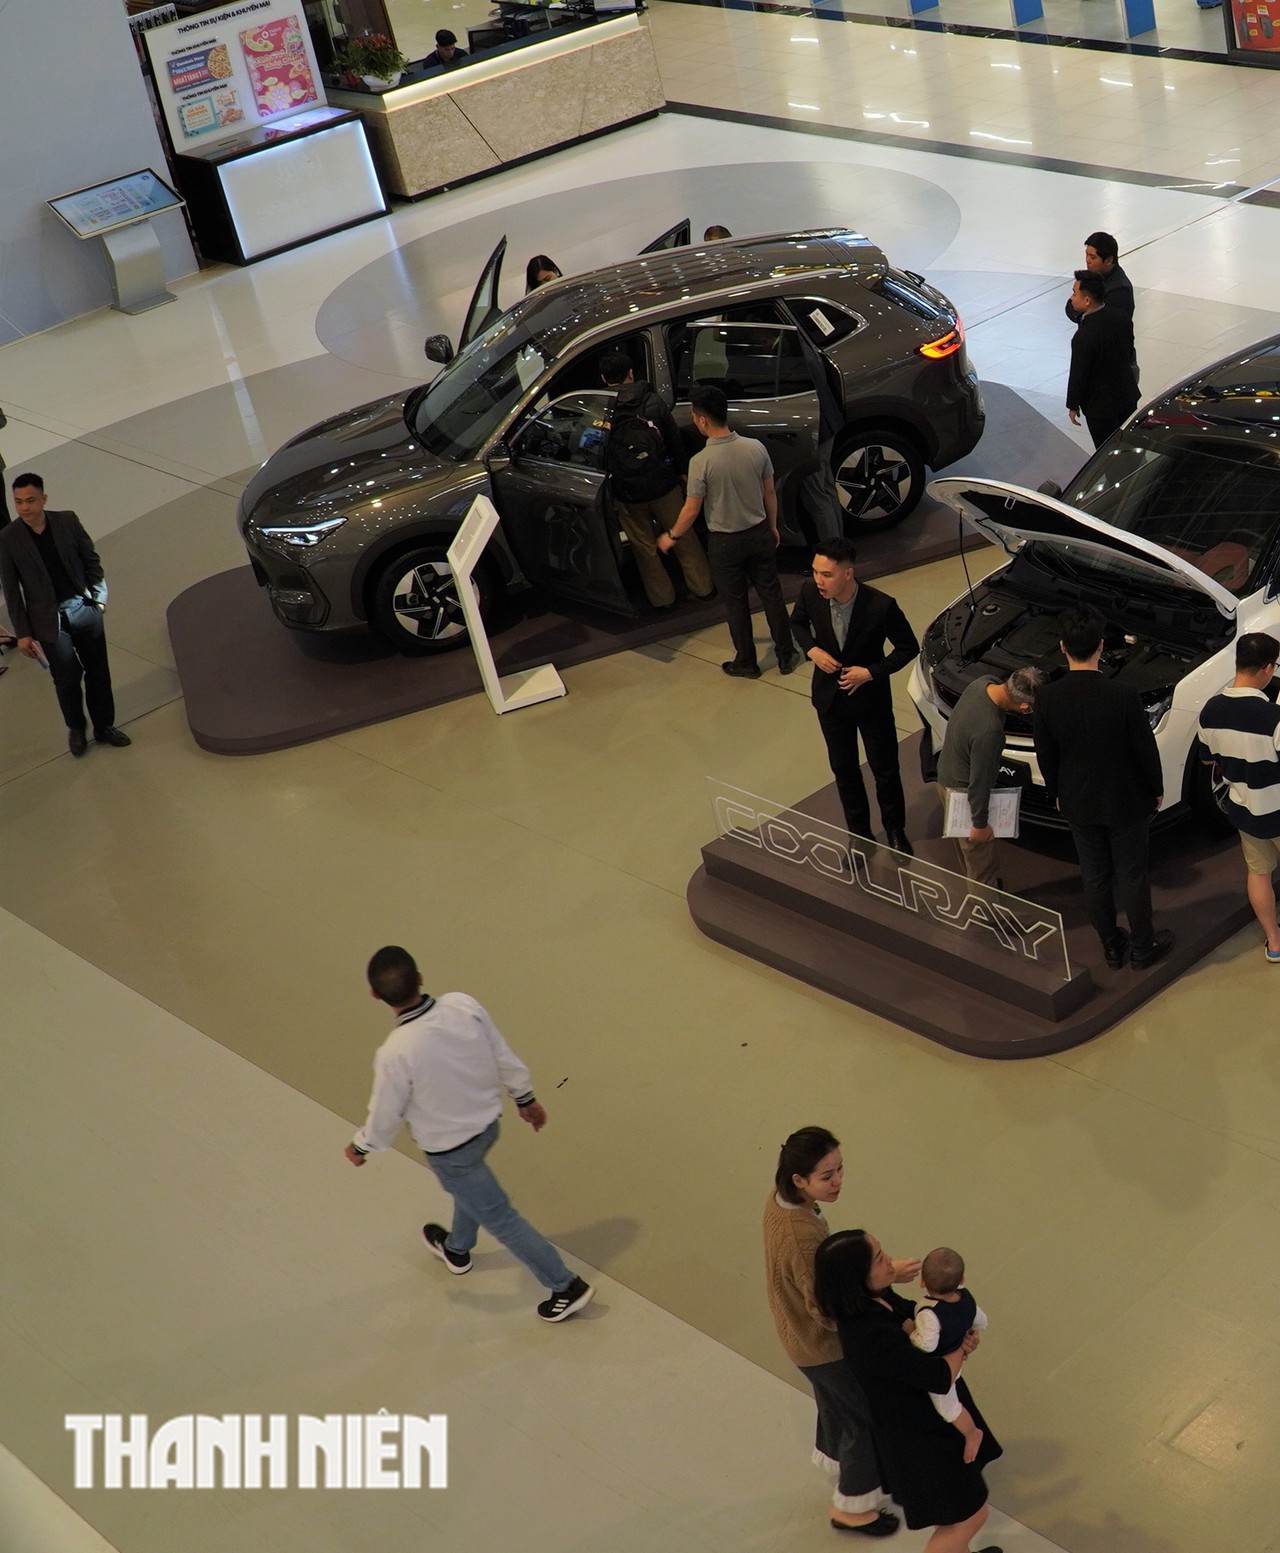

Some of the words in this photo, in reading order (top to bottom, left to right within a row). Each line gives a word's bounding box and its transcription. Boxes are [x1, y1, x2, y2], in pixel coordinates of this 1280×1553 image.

[177, 22, 200, 34] THÔNG
[200, 18, 209, 28] TIN
[714, 796, 1057, 960] COOLRAY
